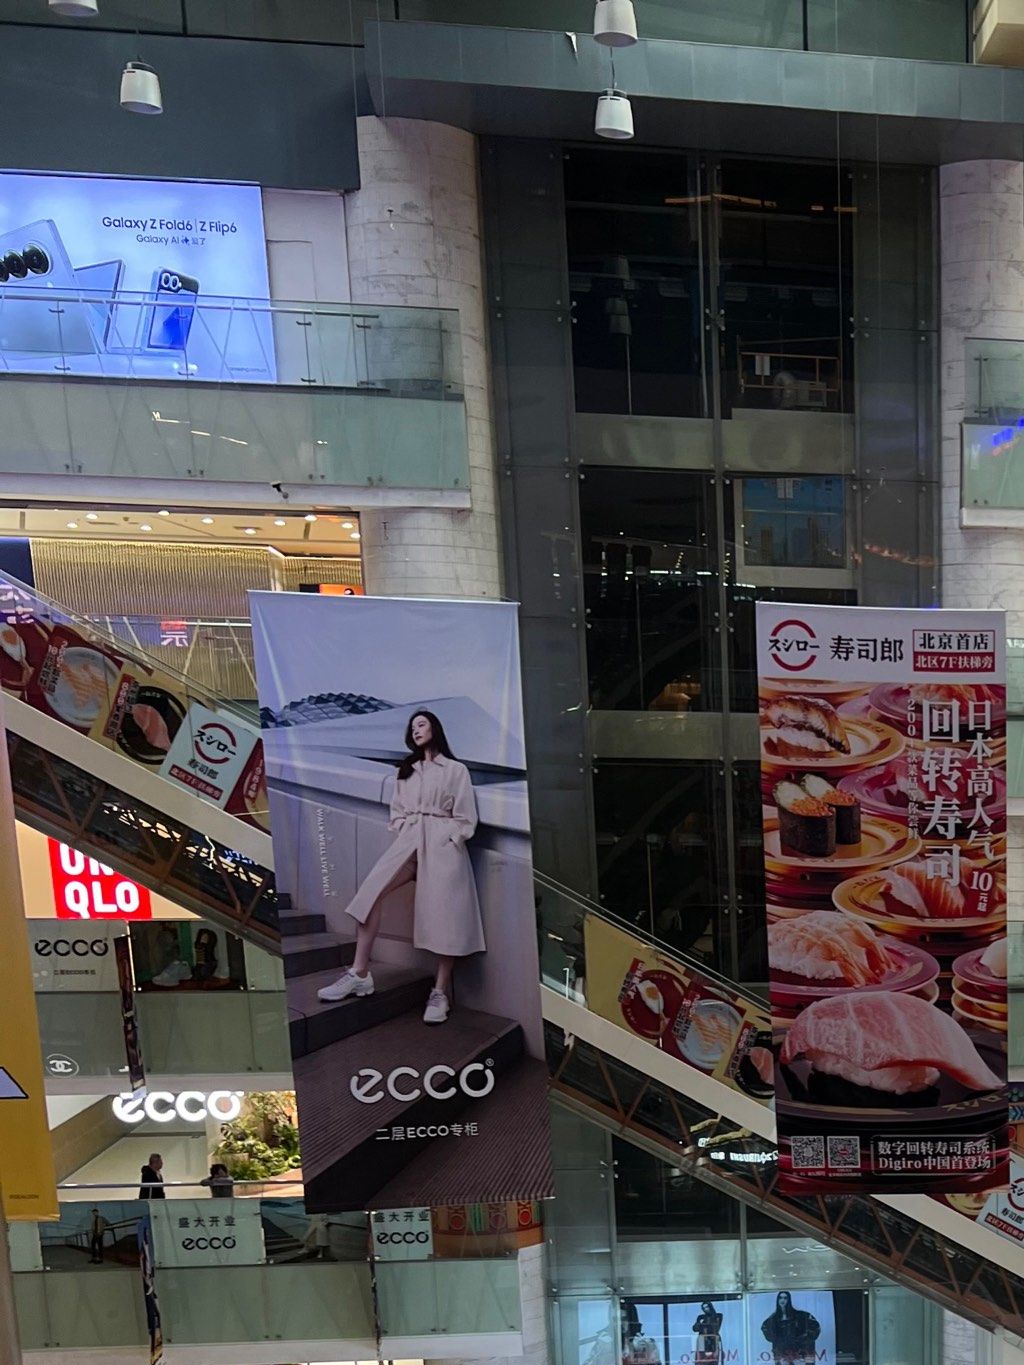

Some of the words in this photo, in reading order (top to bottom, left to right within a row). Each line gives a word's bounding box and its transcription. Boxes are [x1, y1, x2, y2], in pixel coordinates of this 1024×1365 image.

[102, 217, 147, 231] Galaxy
[150, 219, 157, 229] Z
[160, 219, 193, 231] Fold6
[200, 221, 207, 231] Z
[210, 221, 237, 236] Flip6
[136, 234, 168, 245] Galaxy
[768, 638, 820, 652] スシロー
[829, 635, 904, 662] 寿司郎
[919, 633, 989, 651] 北京首店
[915, 656, 993, 669] 北区7F扶梯旁
[194, 730, 236, 755] スシロー
[966, 699, 994, 861] 日本高人气
[921, 698, 963, 887] 回转寿司
[65, 881, 139, 919] QLO
[35, 938, 109, 957] ecco
[350, 1061, 495, 1103] ecco
[112, 1090, 241, 1122] ecco
[375, 1121, 480, 1142] 二层ECCO专柜
[878, 1141, 990, 1155] 数字回转寿司系统
[178, 1215, 236, 1228] 盛大开业
[374, 1211, 430, 1223] 盛大开业
[182, 1236, 236, 1250] ecco
[377, 1231, 430, 1245] ecco
